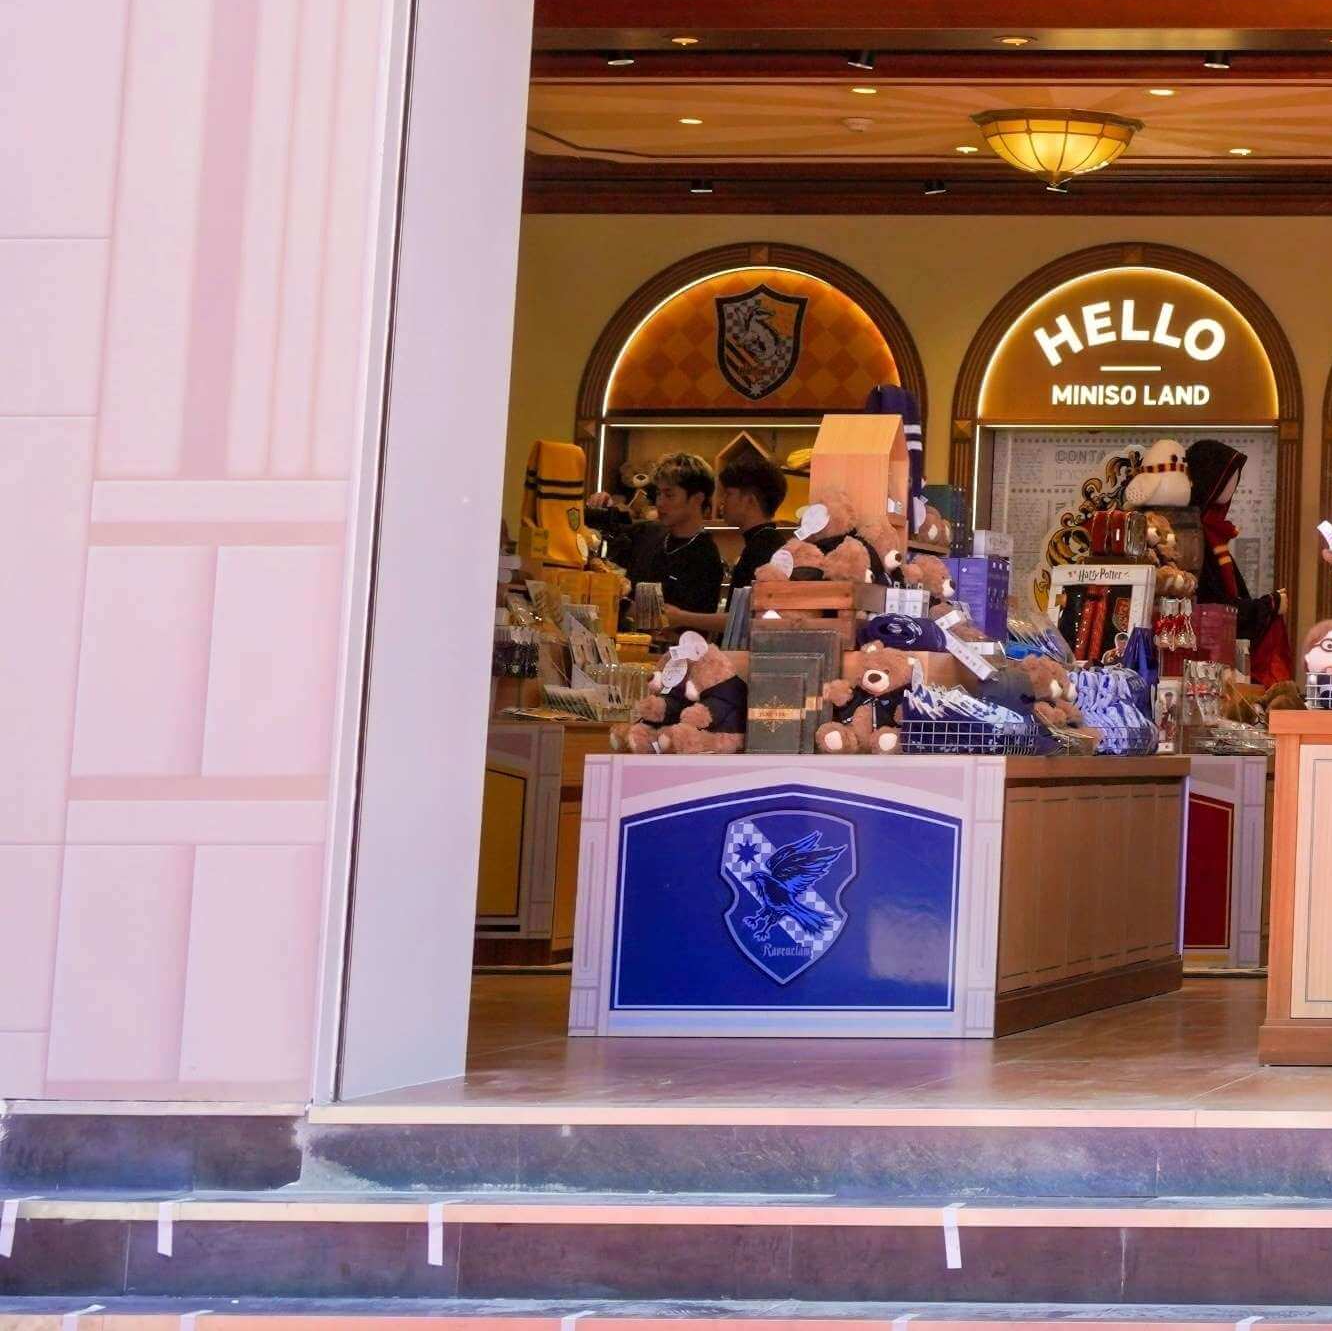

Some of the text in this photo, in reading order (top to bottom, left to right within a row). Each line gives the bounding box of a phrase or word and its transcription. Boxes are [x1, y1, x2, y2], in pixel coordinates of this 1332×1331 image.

[1033, 298, 1226, 367] HELLO
[1051, 384, 1210, 406] MINISO LAND
